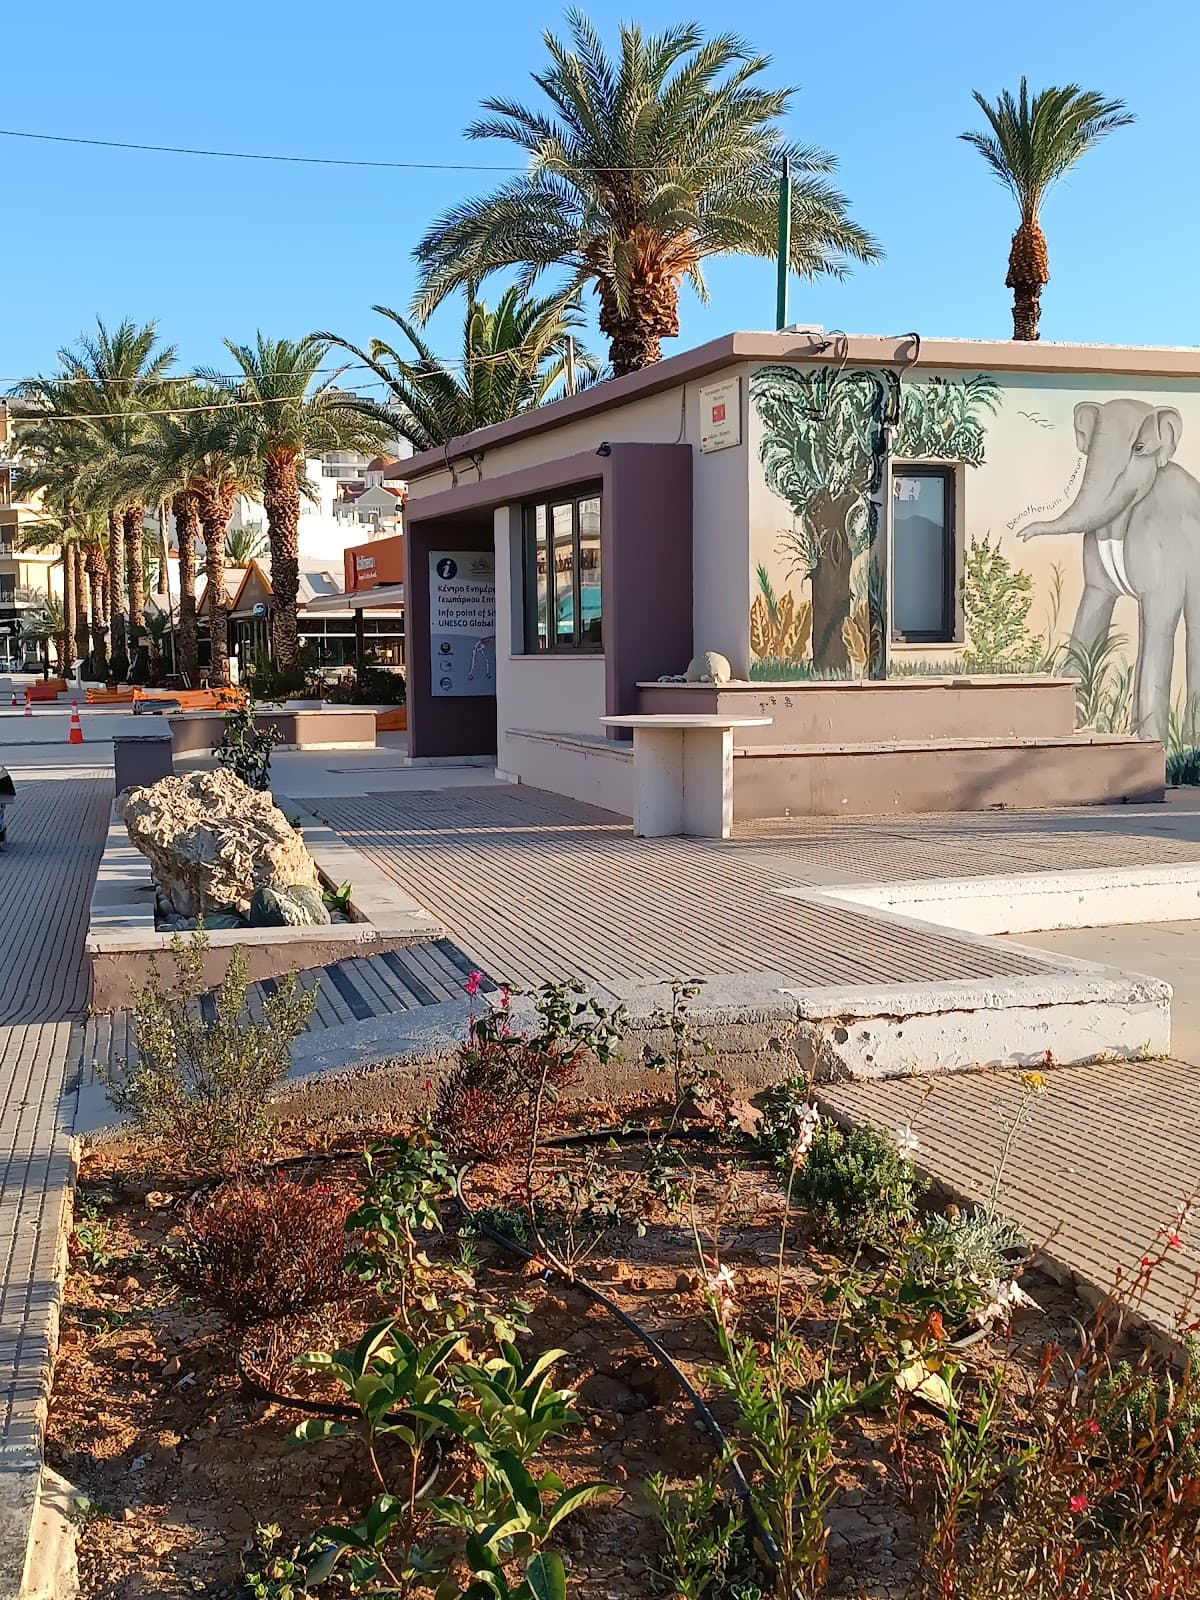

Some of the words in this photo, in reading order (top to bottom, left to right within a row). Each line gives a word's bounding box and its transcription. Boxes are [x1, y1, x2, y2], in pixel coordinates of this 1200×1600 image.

[1006, 498, 1062, 530] Deinotherium
[1063, 457, 1083, 498] proavum
[438, 585, 465, 594] Κέντρο
[438, 608, 454, 618] Info
[455, 608, 476, 618] point
[477, 608, 486, 618] of
[438, 619, 468, 627] UNESCO
[470, 619, 494, 627] Global
